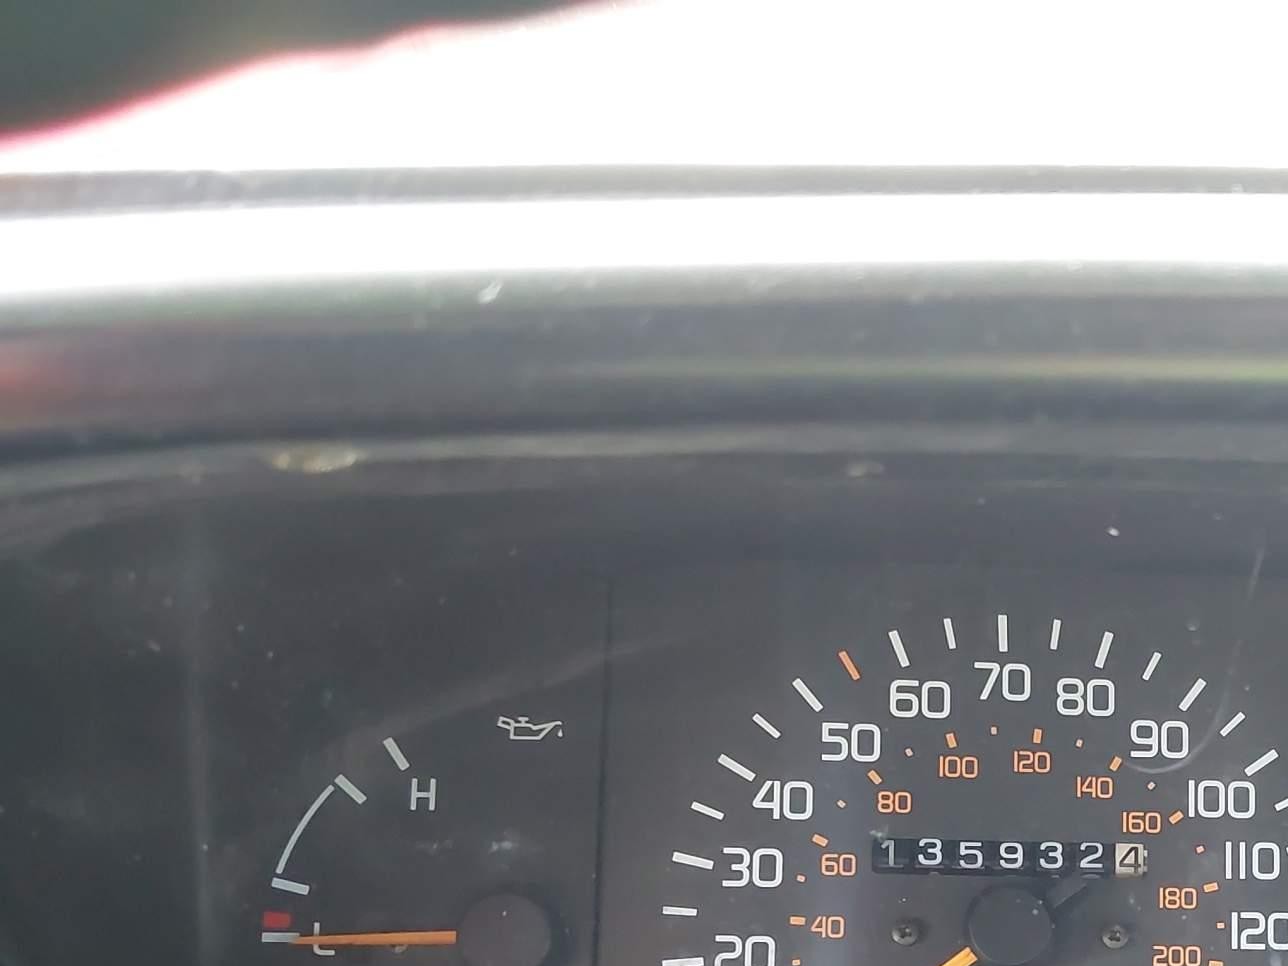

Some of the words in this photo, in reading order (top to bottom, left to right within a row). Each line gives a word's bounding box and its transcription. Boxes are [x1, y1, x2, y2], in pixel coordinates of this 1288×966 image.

[889, 679, 951, 719] 60
[973, 661, 1031, 702] 70
[1056, 677, 1115, 717] 80
[821, 722, 881, 762] 50
[1130, 720, 1189, 759] 90
[938, 755, 979, 779] 100
[1013, 751, 1051, 773] 120
[410, 777, 437, 811] H
[752, 780, 814, 820] 40
[877, 791, 912, 814] 80
[1076, 776, 1114, 799] 140
[1188, 779, 1256, 819] 100
[1122, 812, 1162, 834] 160
[721, 847, 784, 888] 30
[820, 853, 857, 876] 60
[1225, 841, 1281, 881] 110
[1159, 888, 1197, 910] 180
[810, 916, 845, 939] 40
